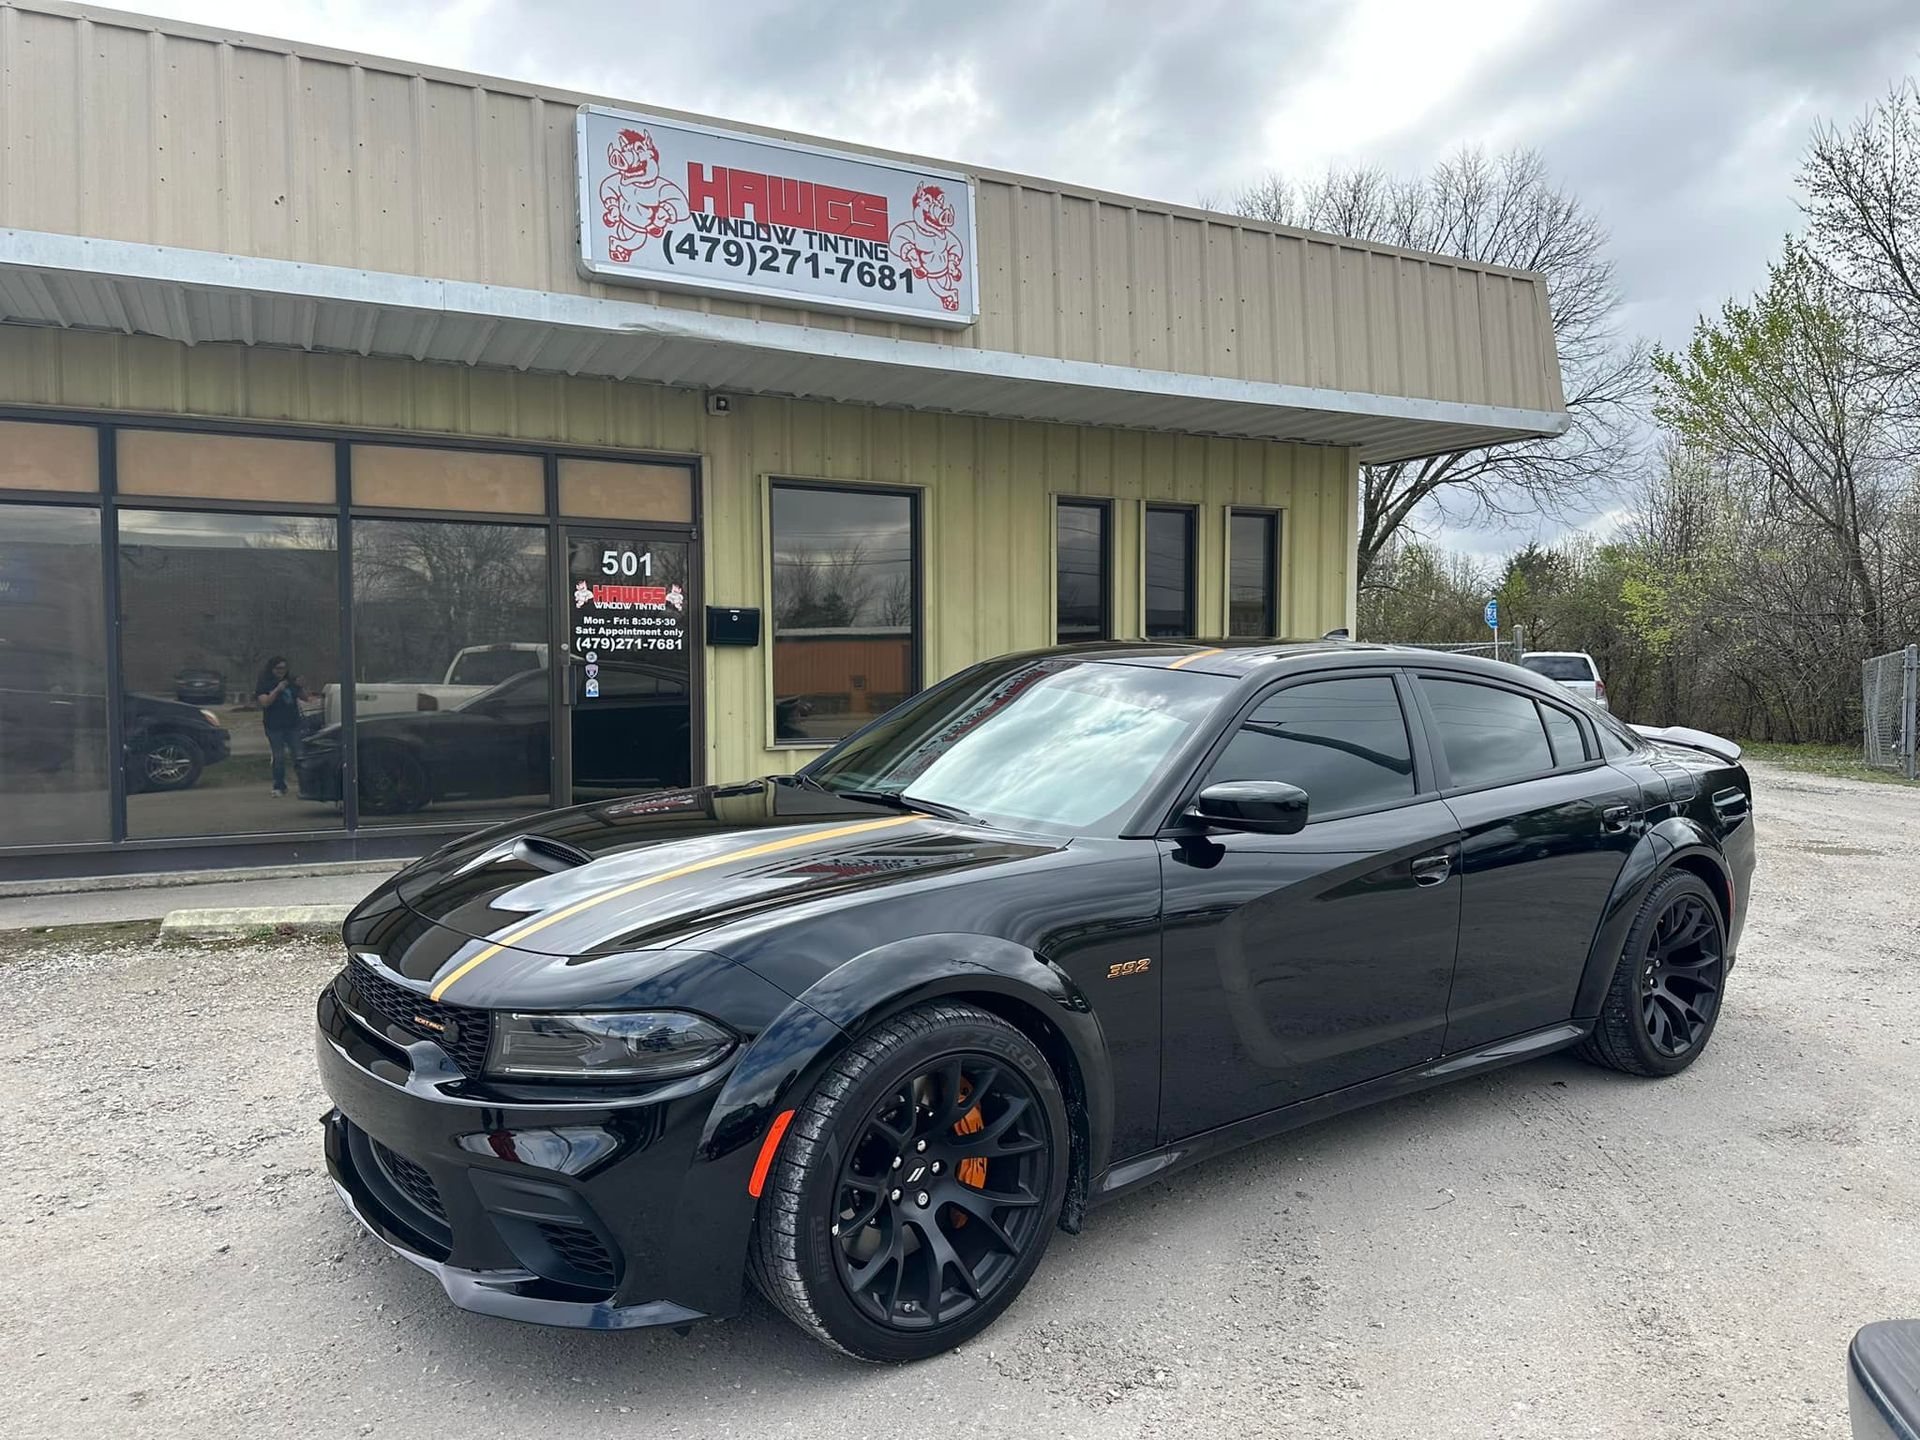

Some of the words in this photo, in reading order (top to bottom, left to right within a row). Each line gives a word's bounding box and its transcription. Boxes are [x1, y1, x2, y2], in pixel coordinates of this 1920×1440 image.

[687, 161, 889, 244] HAWGS
[690, 212, 798, 246] WINDOW
[803, 230, 890, 263] TINTING
[662, 229, 914, 295] (479)271-7681
[602, 551, 652, 576] 501
[593, 585, 666, 603] HAWGS
[594, 602, 632, 610] WINDOW
[634, 603, 667, 611] TINTING
[583, 616, 605, 625] Mon
[613, 617, 630, 625] Fri:
[575, 626, 596, 635] Sat:
[598, 626, 661, 637] Appointment
[663, 628, 684, 638] only
[576, 637, 683, 652] (479)271-7681
[1107, 958, 1151, 979] 392
